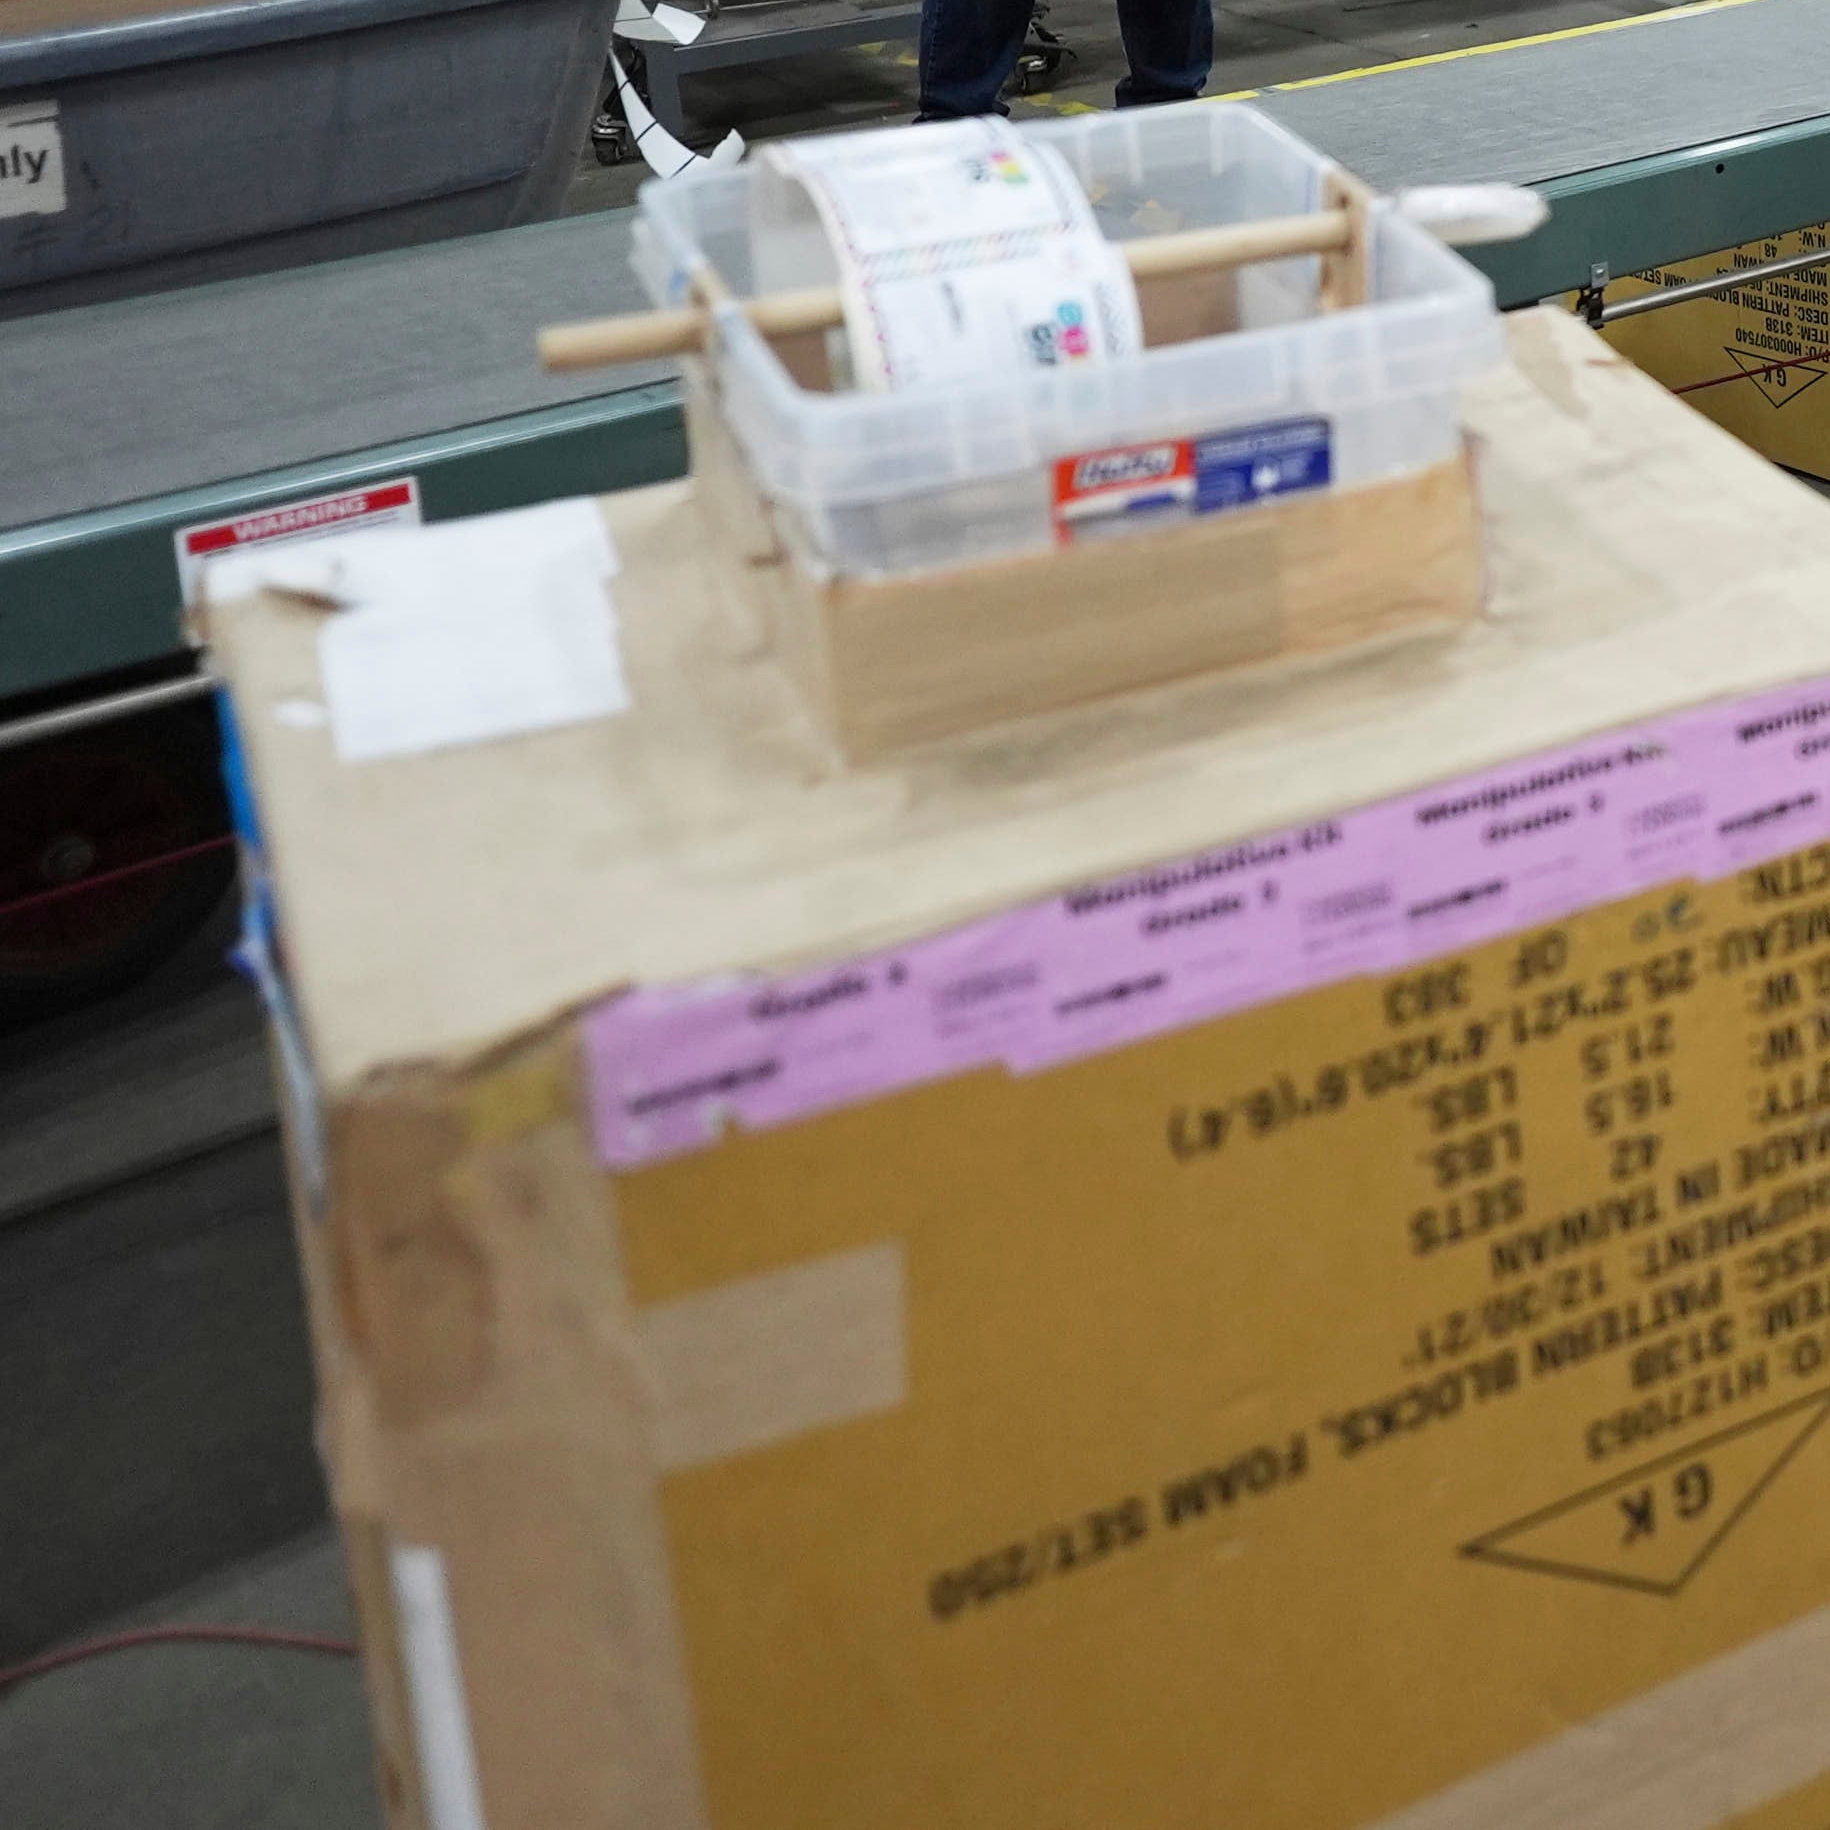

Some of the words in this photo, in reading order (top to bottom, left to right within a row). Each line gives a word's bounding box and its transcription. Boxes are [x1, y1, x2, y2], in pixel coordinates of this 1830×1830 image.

[1741, 293, 1790, 319] PATTERN
[1765, 281, 1829, 307] SHIPMENT:
[1793, 306, 1829, 326] DESC:
[1735, 328, 1802, 357] H000307540
[1765, 316, 1794, 338] 313B
[1797, 324, 1830, 345] ITEM:
[1761, 363, 1773, 385] K
[1776, 368, 1787, 387] G
[233, 495, 368, 541] WARNING
[1511, 931, 1569, 989] OF
[1610, 1134, 1661, 1184] 42
[1676, 1163, 1721, 1210] IN
[1409, 1177, 1527, 1259] SETS
[1490, 1185, 1658, 1277] TAIWAN
[1530, 1273, 1723, 1378] PATTERN
[1161, 1430, 1309, 1531] FOAM
[1673, 1462, 1714, 1520] G
[1619, 1488, 1657, 1549] K
[926, 1495, 1148, 1626] SET/250
